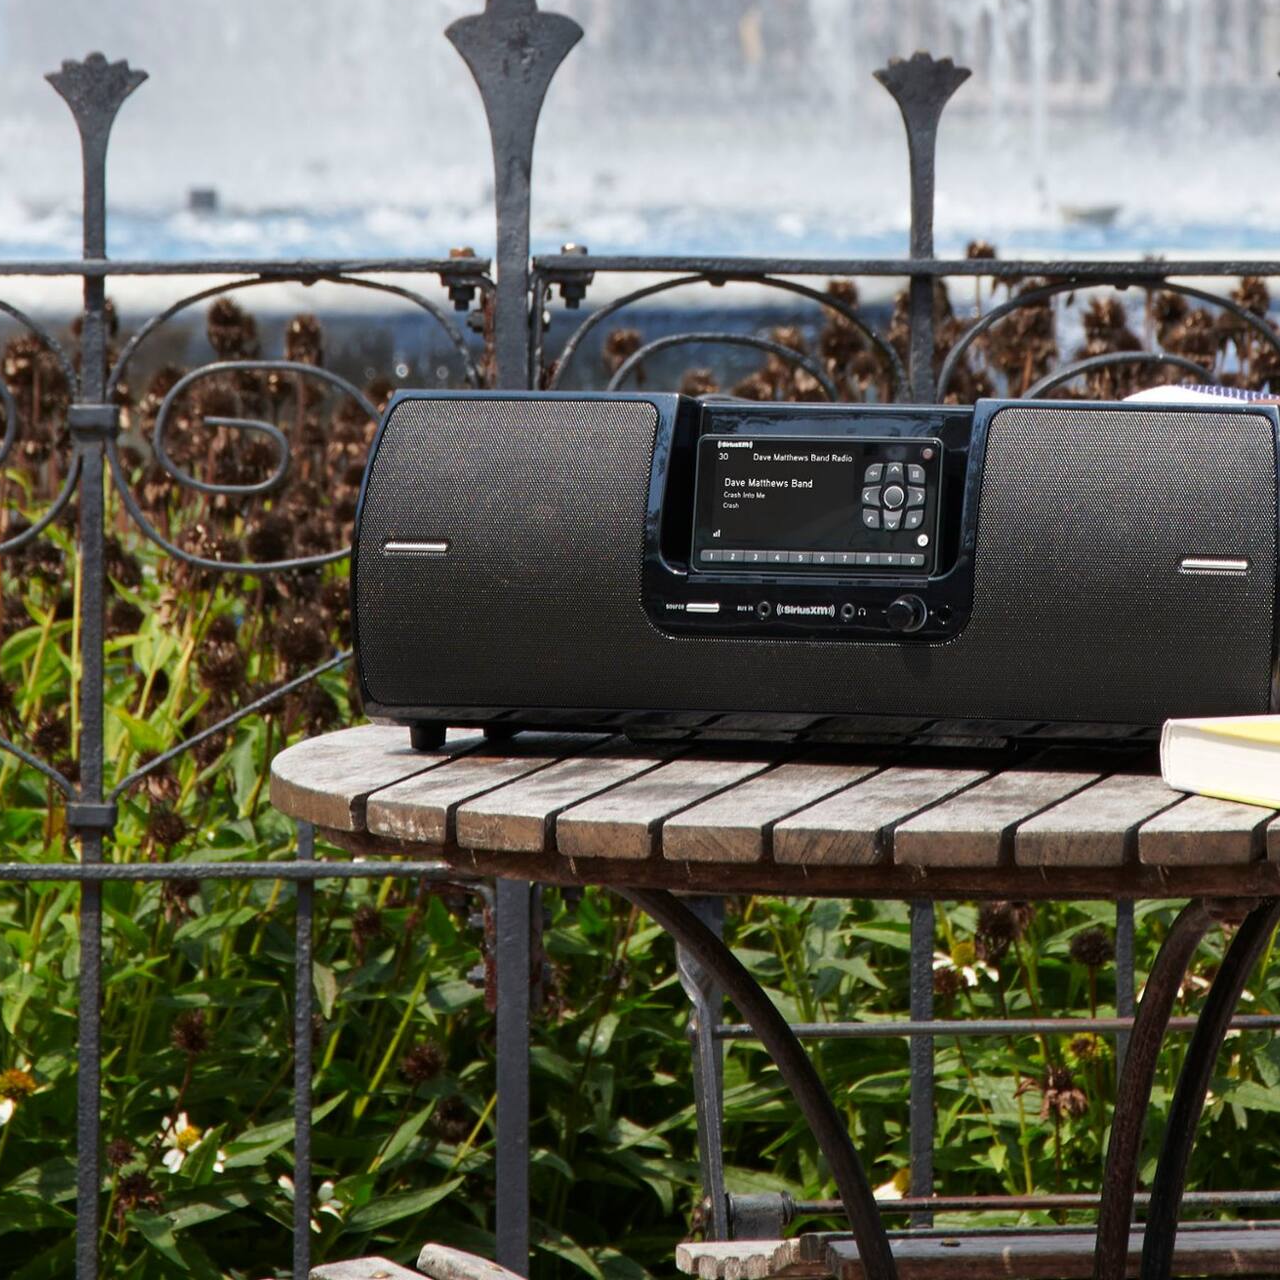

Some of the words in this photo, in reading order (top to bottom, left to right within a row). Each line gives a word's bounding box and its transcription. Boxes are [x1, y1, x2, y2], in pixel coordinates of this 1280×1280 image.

[719, 452, 729, 461] 30
[753, 453, 772, 461] Dave
[773, 453, 809, 462] Matthews
[810, 454, 830, 462] Band
[831, 454, 853, 463] Radio
[724, 478, 746, 487] Dave
[748, 478, 789, 488] Matthews
[791, 479, 813, 489] Band
[723, 491, 741, 499] Crash
